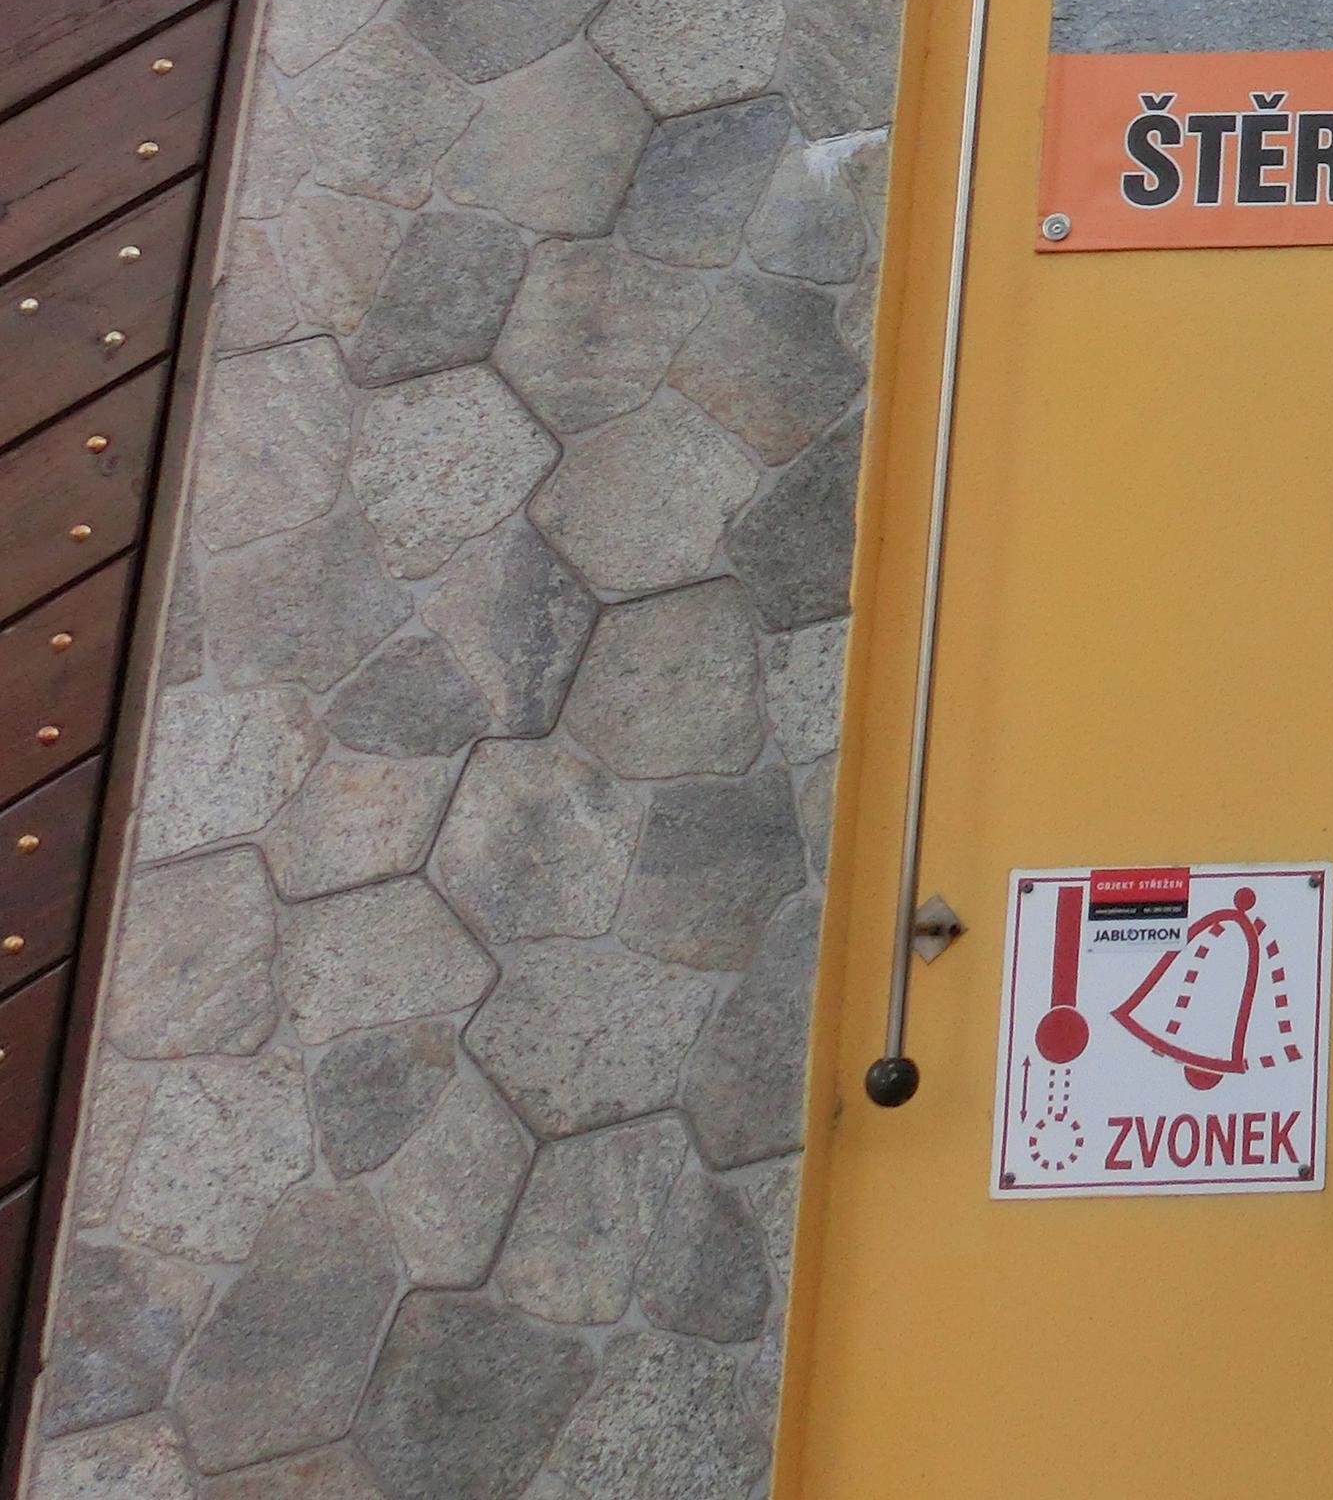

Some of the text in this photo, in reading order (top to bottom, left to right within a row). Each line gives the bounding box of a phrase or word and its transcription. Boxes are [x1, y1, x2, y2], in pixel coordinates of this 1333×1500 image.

[1096, 877, 1184, 891] OBJEKT STŘEŽEN
[1093, 927, 1181, 943] JABLOTRON
[1104, 1111, 1301, 1171] ZVONEK
